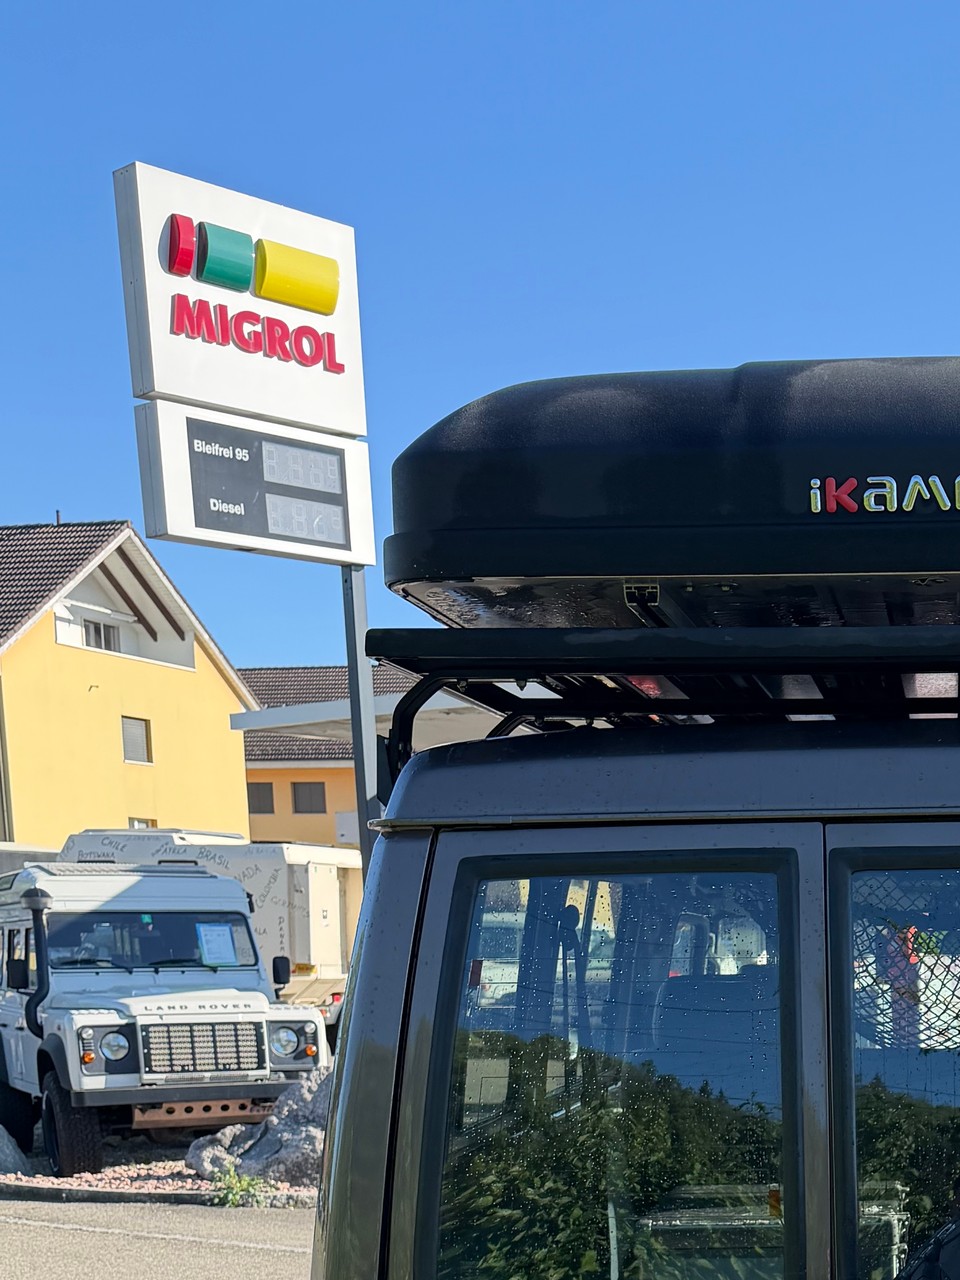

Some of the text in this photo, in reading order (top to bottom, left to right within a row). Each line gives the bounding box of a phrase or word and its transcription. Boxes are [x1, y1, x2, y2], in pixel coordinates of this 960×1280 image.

[170, 293, 345, 374] MIGROL
[193, 439, 250, 462] Bleifrei 95
[209, 498, 245, 516] Diesel
[101, 837, 128, 852] CHILE
[196, 847, 231, 870] BRASIL
[234, 864, 263, 883] NADA
[254, 927, 268, 935] ALA
[278, 916, 286, 957] PANAM
